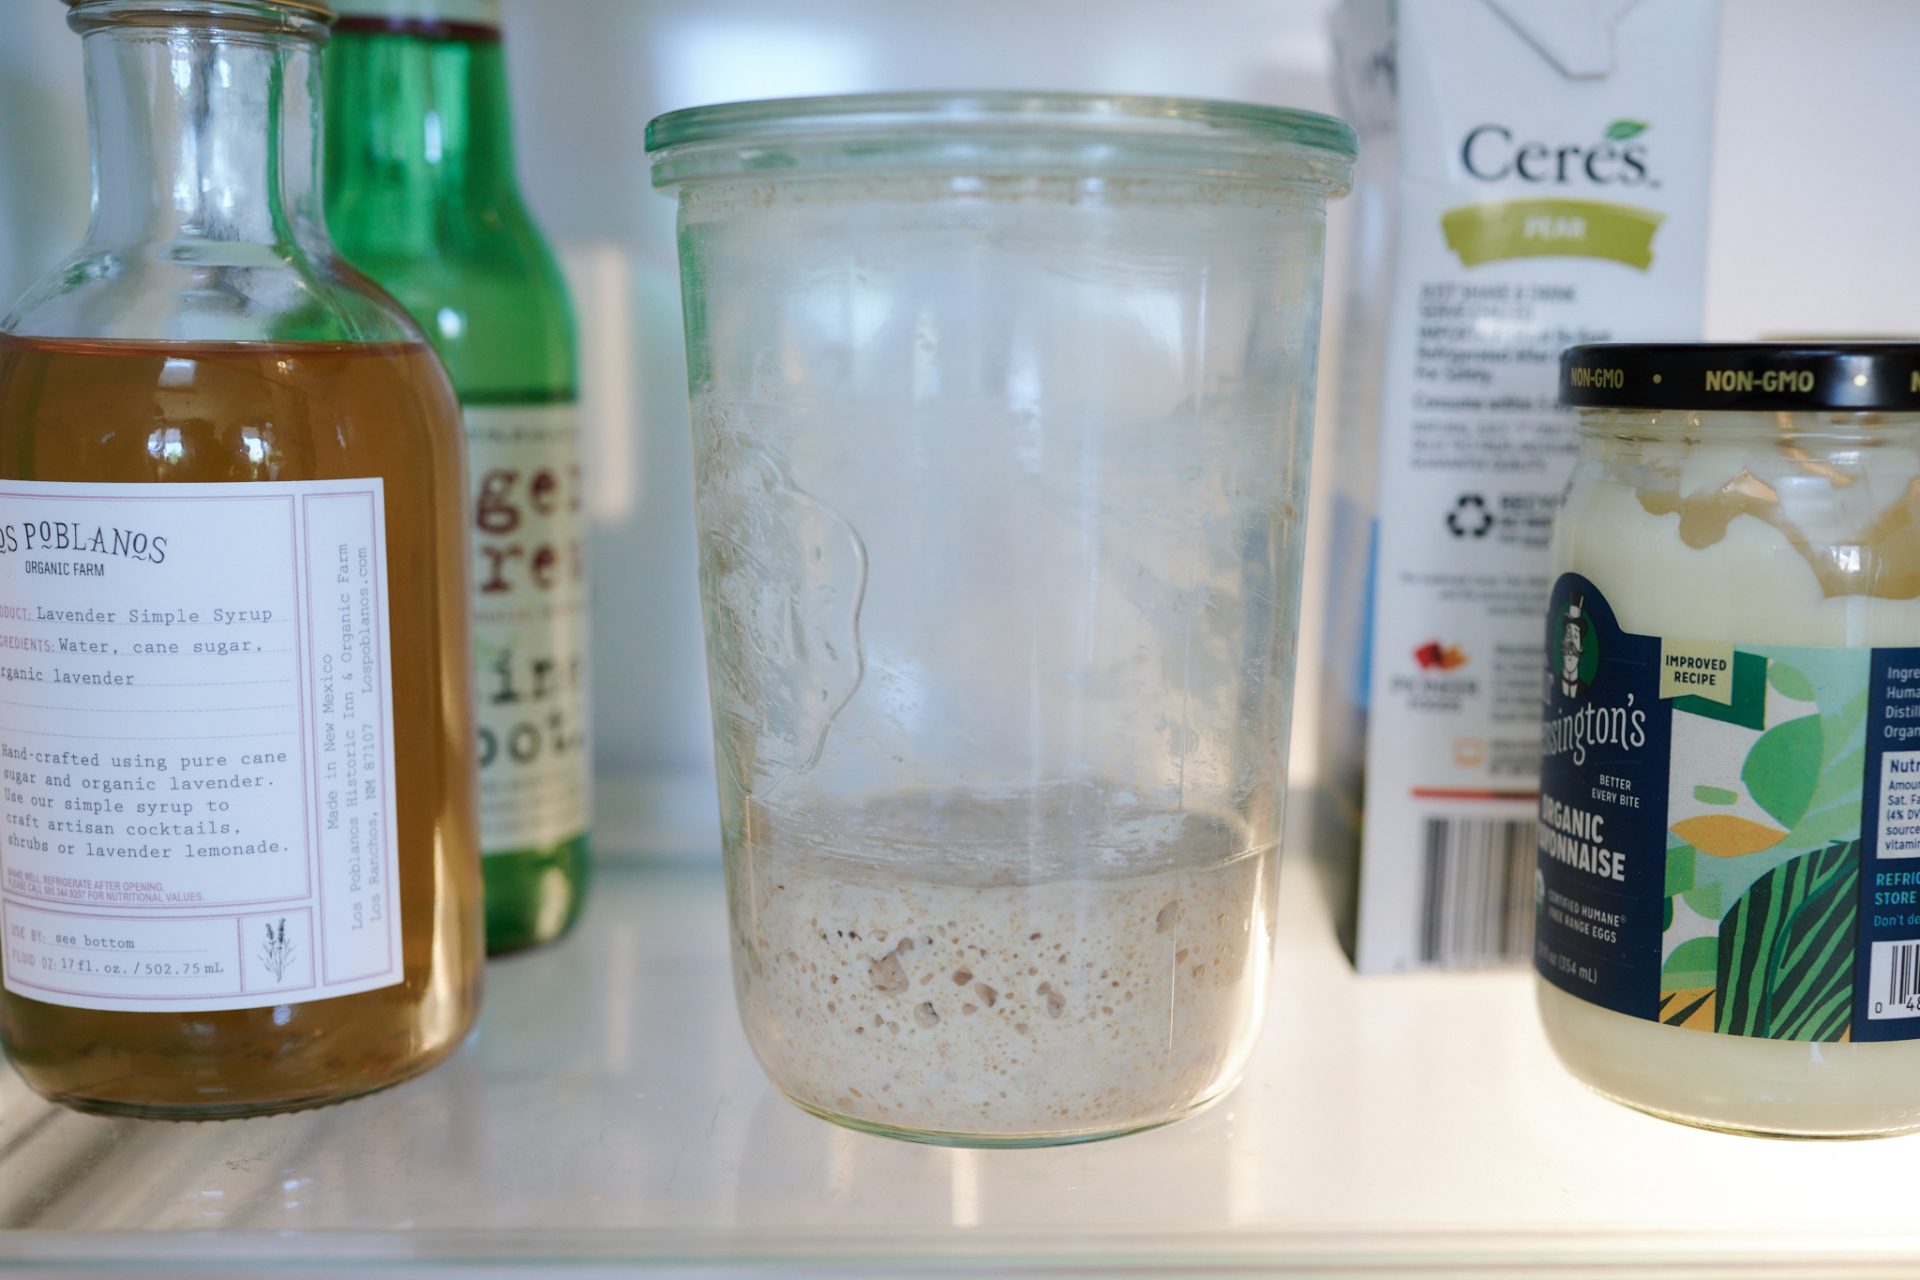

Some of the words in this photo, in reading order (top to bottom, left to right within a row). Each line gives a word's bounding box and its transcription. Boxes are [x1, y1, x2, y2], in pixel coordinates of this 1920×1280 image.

[1461, 122, 1648, 186] Ceres
[1570, 366, 1625, 390] NON-GMO
[1705, 370, 1815, 393] NON-GMO
[22, 520, 168, 564] POBLANOS
[25, 560, 70, 576] ORGANIC
[73, 562, 105, 577] FARM
[338, 543, 350, 584] Farm
[36, 606, 117, 623] Lavender
[129, 608, 200, 626] Simple
[213, 608, 273, 625] Syrup
[339, 593, 354, 663] Organic
[358, 547, 375, 694] Lospoblanos.com
[58, 637, 119, 655] Water,
[133, 641, 179, 653] cane
[193, 641, 262, 656] sugar,
[1665, 653, 1727, 671] IMPROVED
[1, 666, 43, 681] rganic
[53, 667, 136, 685] lavender
[321, 654, 335, 714] Mexico
[343, 673, 353, 682] &
[1673, 670, 1717, 686] RECIPE
[343, 691, 355, 720] Inn
[325, 722, 336, 753] New
[1544, 693, 1646, 766] sington's
[1, 743, 100, 768] Hand-crafted
[111, 754, 168, 771] using
[180, 755, 228, 771] pure
[240, 752, 288, 765] cane
[362, 723, 375, 770] 87107
[3, 768, 37, 785] sugar
[45, 774, 72, 788] and
[81, 776, 156, 793] organic
[170, 774, 274, 791] lavender.
[325, 761, 336, 780] in
[344, 729, 358, 808] Historic
[365, 779, 377, 800] NM
[1599, 773, 1632, 791] BETTER
[4, 787, 24, 804] Use
[31, 796, 54, 809] our
[64, 797, 125, 815] simple
[136, 802, 193, 817] syrup
[206, 799, 230, 812] to
[328, 790, 338, 830] Made
[1591, 787, 1618, 804] EVERY
[1619, 794, 1641, 809] BITE
[1887, 794, 1907, 806] Sat.
[6, 813, 40, 829] craft
[48, 820, 115, 835] artisan
[8, 832, 49, 852] shrubs
[58, 843, 75, 855] or
[86, 842, 172, 858] lavender
[185, 839, 289, 857] lemonade.
[349, 816, 362, 893] Poblanos
[367, 811, 380, 885] Ranchos,
[43, 875, 92, 890] REFRIGERATE
[94, 880, 120, 891] AFTER
[88, 889, 104, 900] FOR
[106, 891, 162, 901] NUTRITIONAL
[371, 894, 382, 922] Los
[1874, 890, 1917, 905] STORE
[352, 902, 363, 930] Los
[1873, 914, 1905, 927] Don't
[11, 924, 25, 940] USE
[31, 928, 45, 944] BY:
[55, 934, 77, 945] see
[84, 934, 135, 949] bottom
[1592, 925, 1617, 944] EGGS
[12, 948, 36, 967] FLUID
[61, 957, 75, 970] 17
[104, 963, 128, 974] oz.
[145, 962, 201, 975] 502.75
[204, 961, 224, 974] mL
[1875, 1001, 1883, 1014] 0
